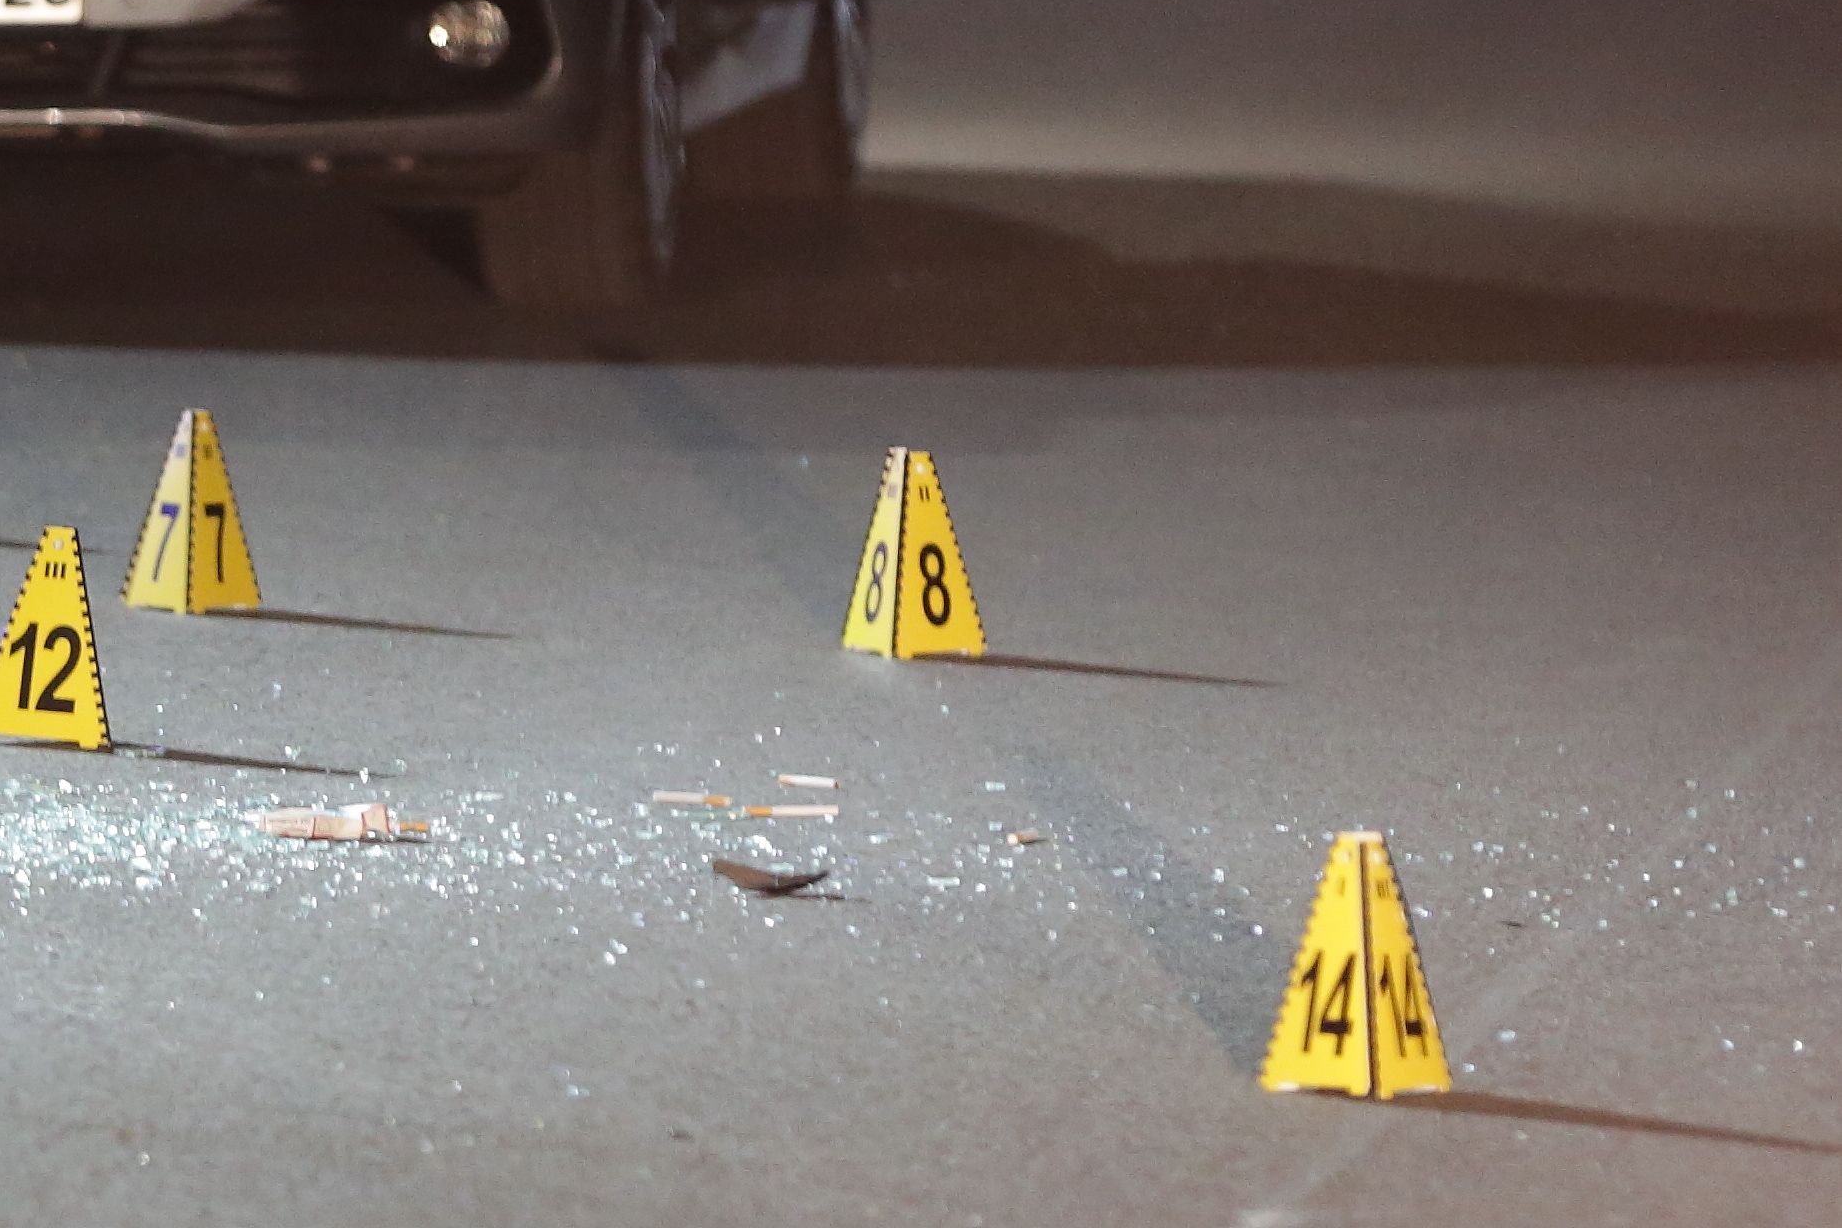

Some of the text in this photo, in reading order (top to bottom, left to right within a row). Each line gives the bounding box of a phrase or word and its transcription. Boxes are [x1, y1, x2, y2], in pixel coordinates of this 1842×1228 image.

[152, 503, 180, 582] 7
[204, 503, 225, 583] 7
[865, 541, 889, 623] 8
[919, 542, 951, 626] 8
[8, 621, 83, 714] 12
[1301, 949, 1357, 1057] 14
[1379, 952, 1430, 1059] 14
